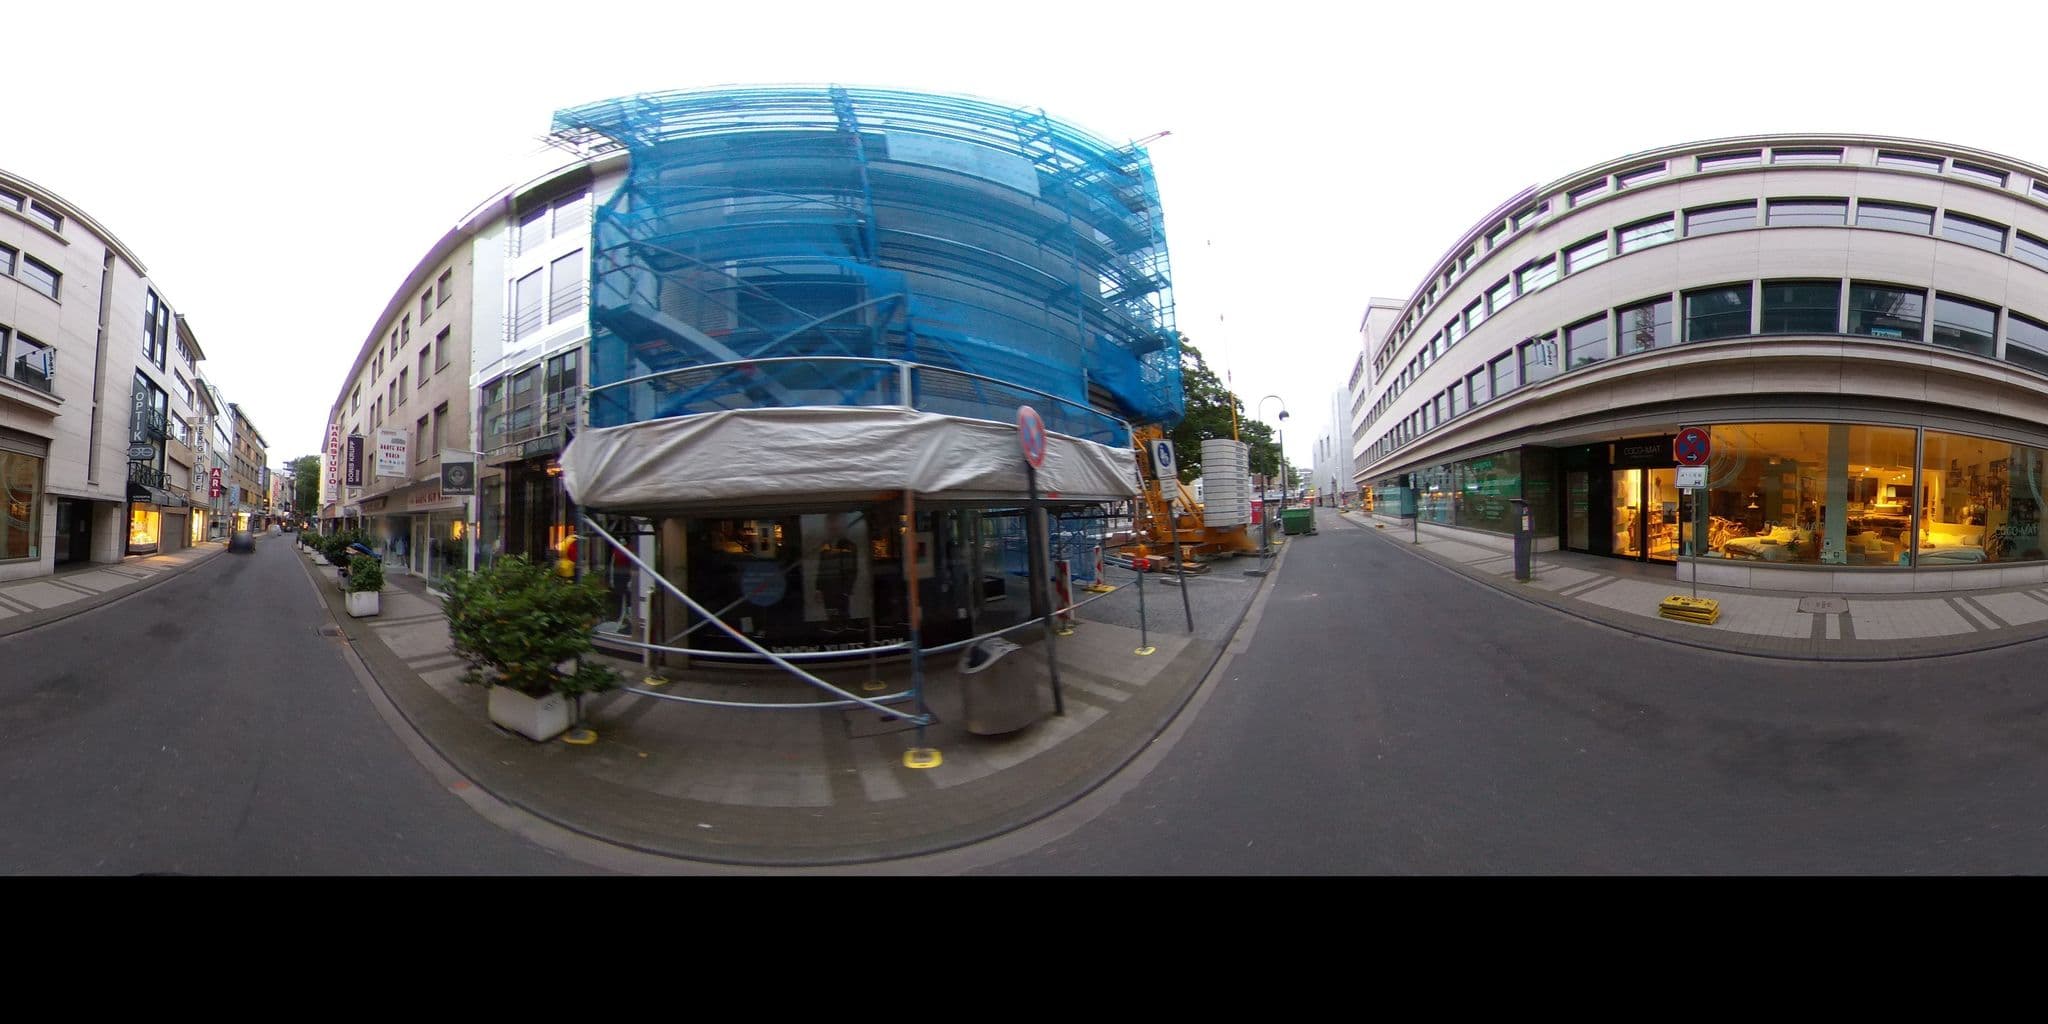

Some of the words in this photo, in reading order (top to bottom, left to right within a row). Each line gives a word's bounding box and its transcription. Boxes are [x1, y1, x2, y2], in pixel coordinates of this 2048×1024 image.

[133, 392, 144, 440] OPTIK
[329, 425, 339, 484] HAARSTUDIO
[212, 469, 220, 497] ART
[1996, 526, 2037, 536] COCO-MAT
